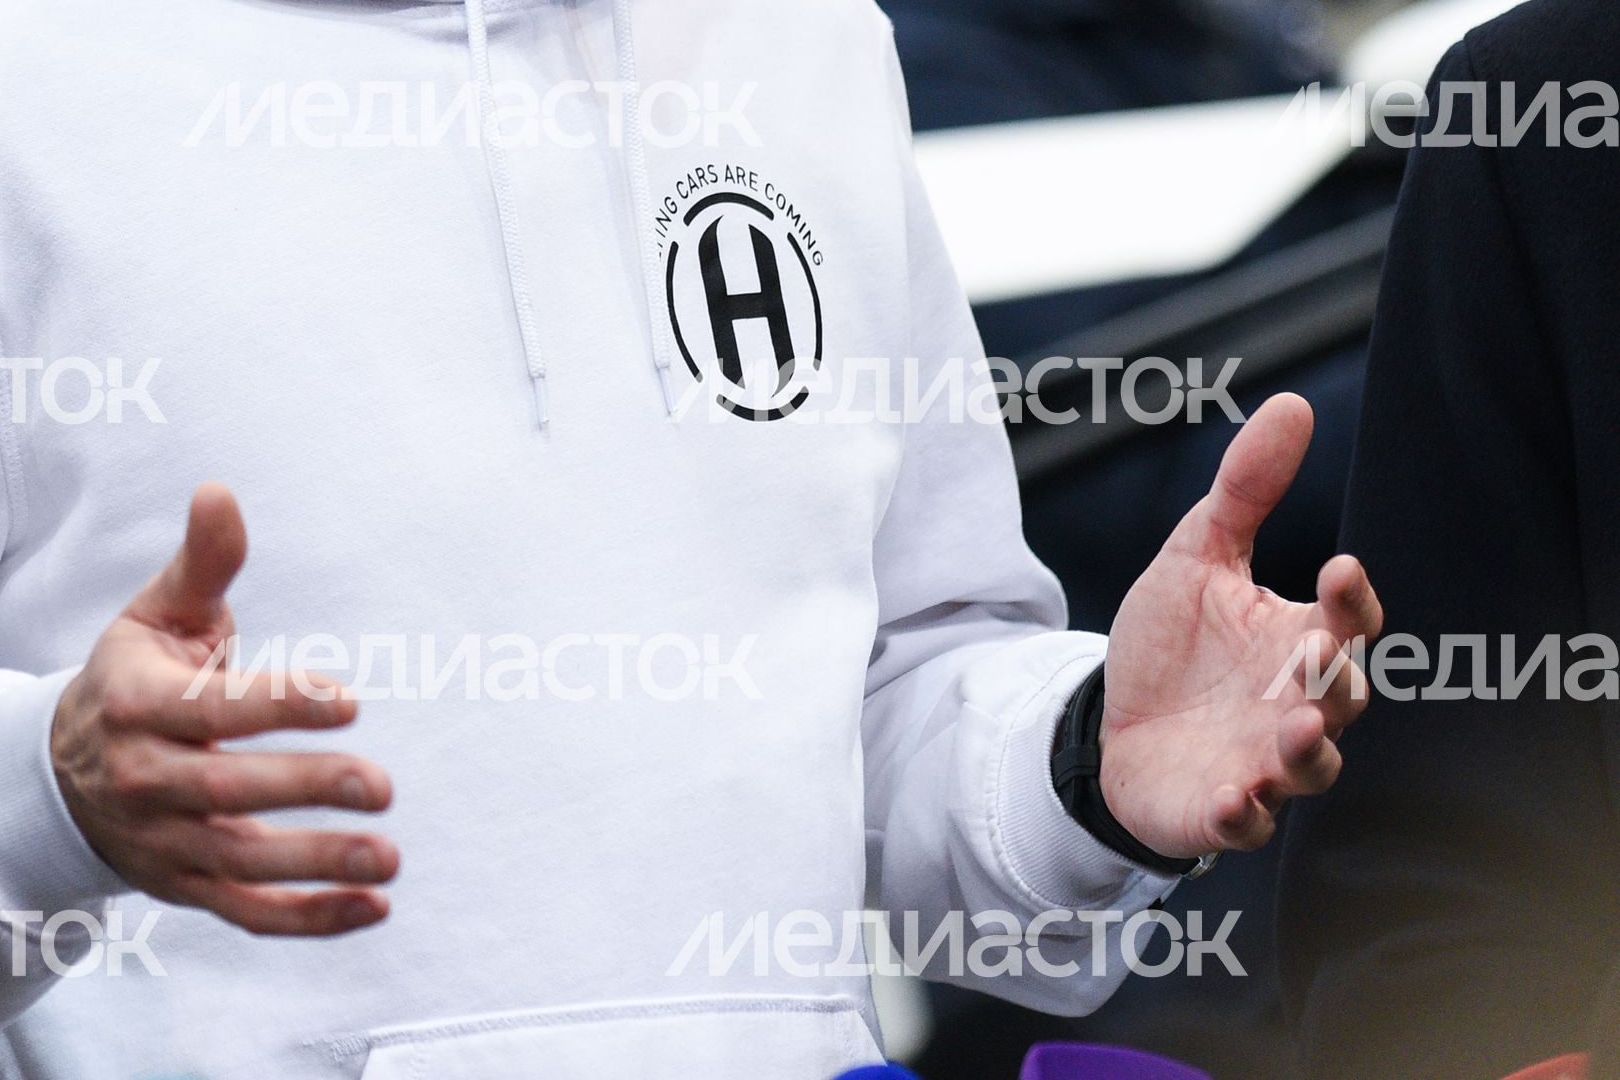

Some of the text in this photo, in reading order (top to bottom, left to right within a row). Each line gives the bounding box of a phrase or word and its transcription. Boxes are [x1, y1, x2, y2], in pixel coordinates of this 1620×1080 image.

[654, 163, 824, 267] ING CARS ARE COMING
